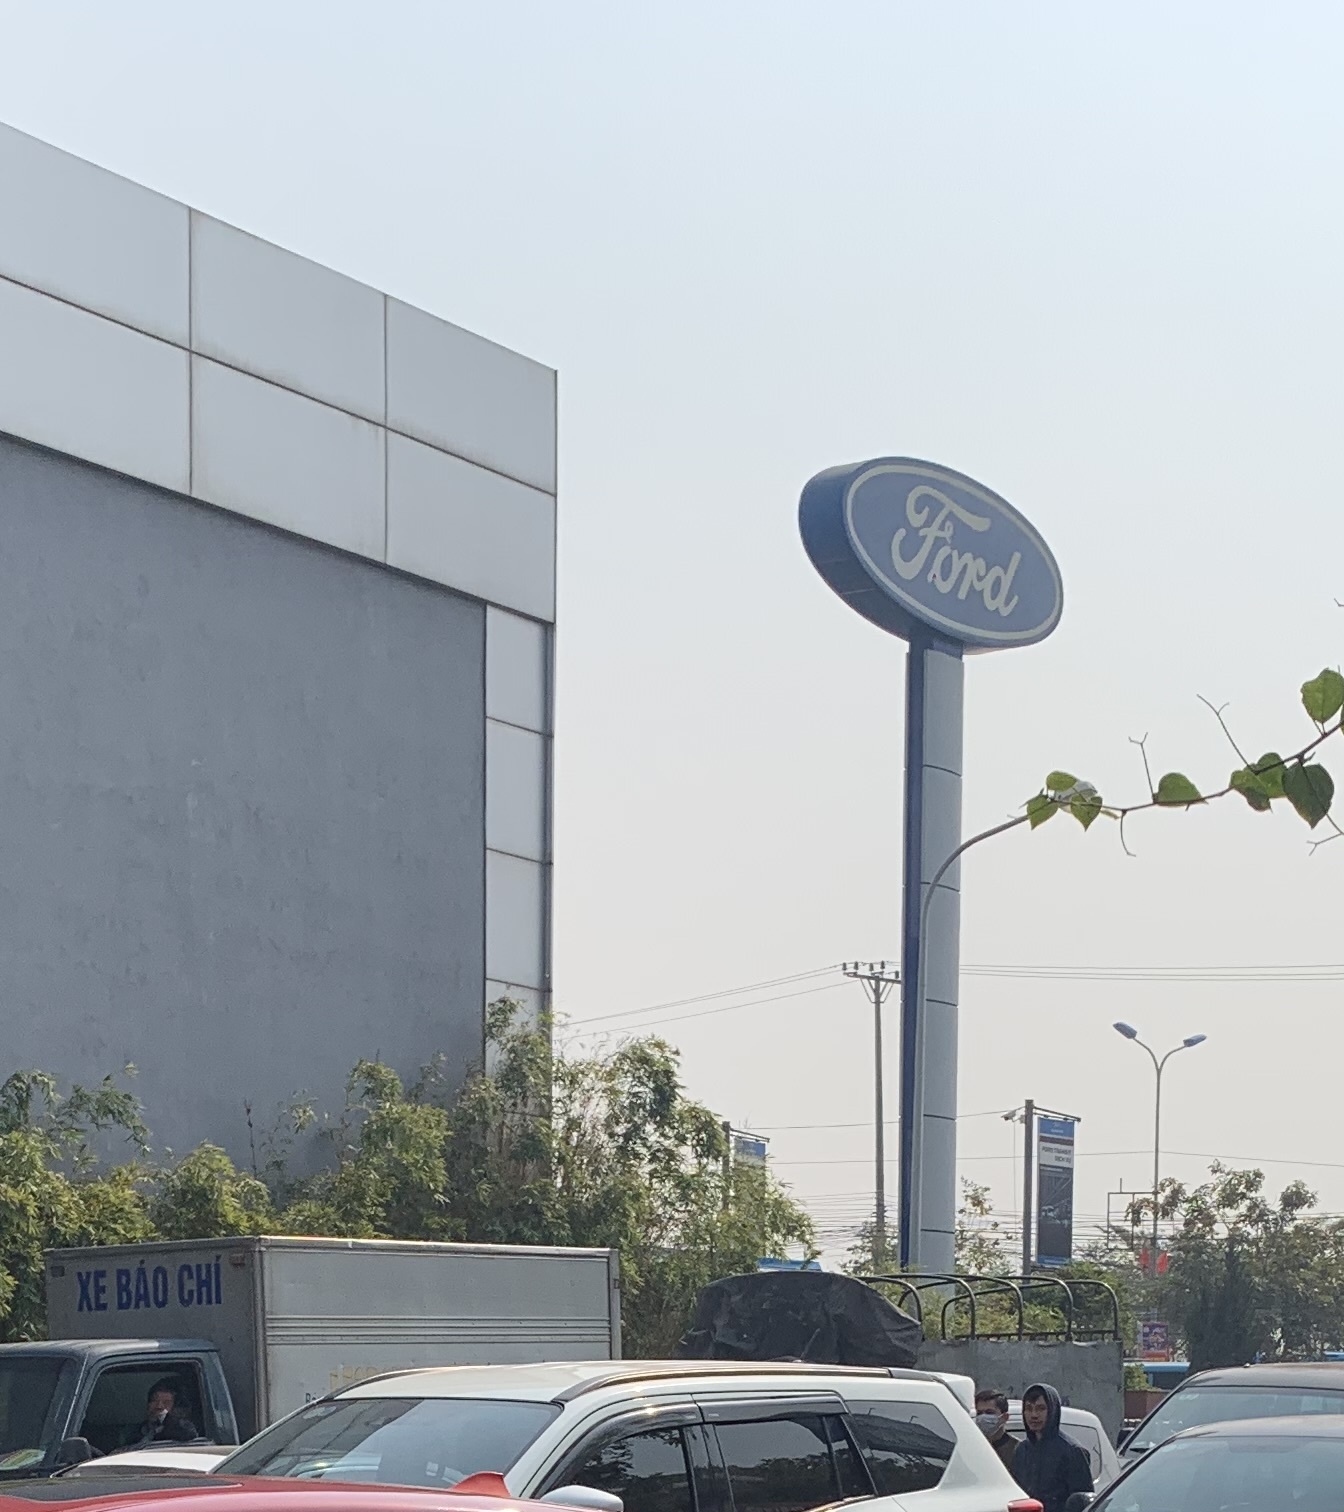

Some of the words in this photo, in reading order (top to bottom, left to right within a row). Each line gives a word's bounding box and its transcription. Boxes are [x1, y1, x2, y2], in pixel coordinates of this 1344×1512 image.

[891, 484, 1022, 616] Ford
[77, 1269, 108, 1312] XE
[116, 1259, 169, 1311] BÁO
[177, 1255, 222, 1308] CHÍ
